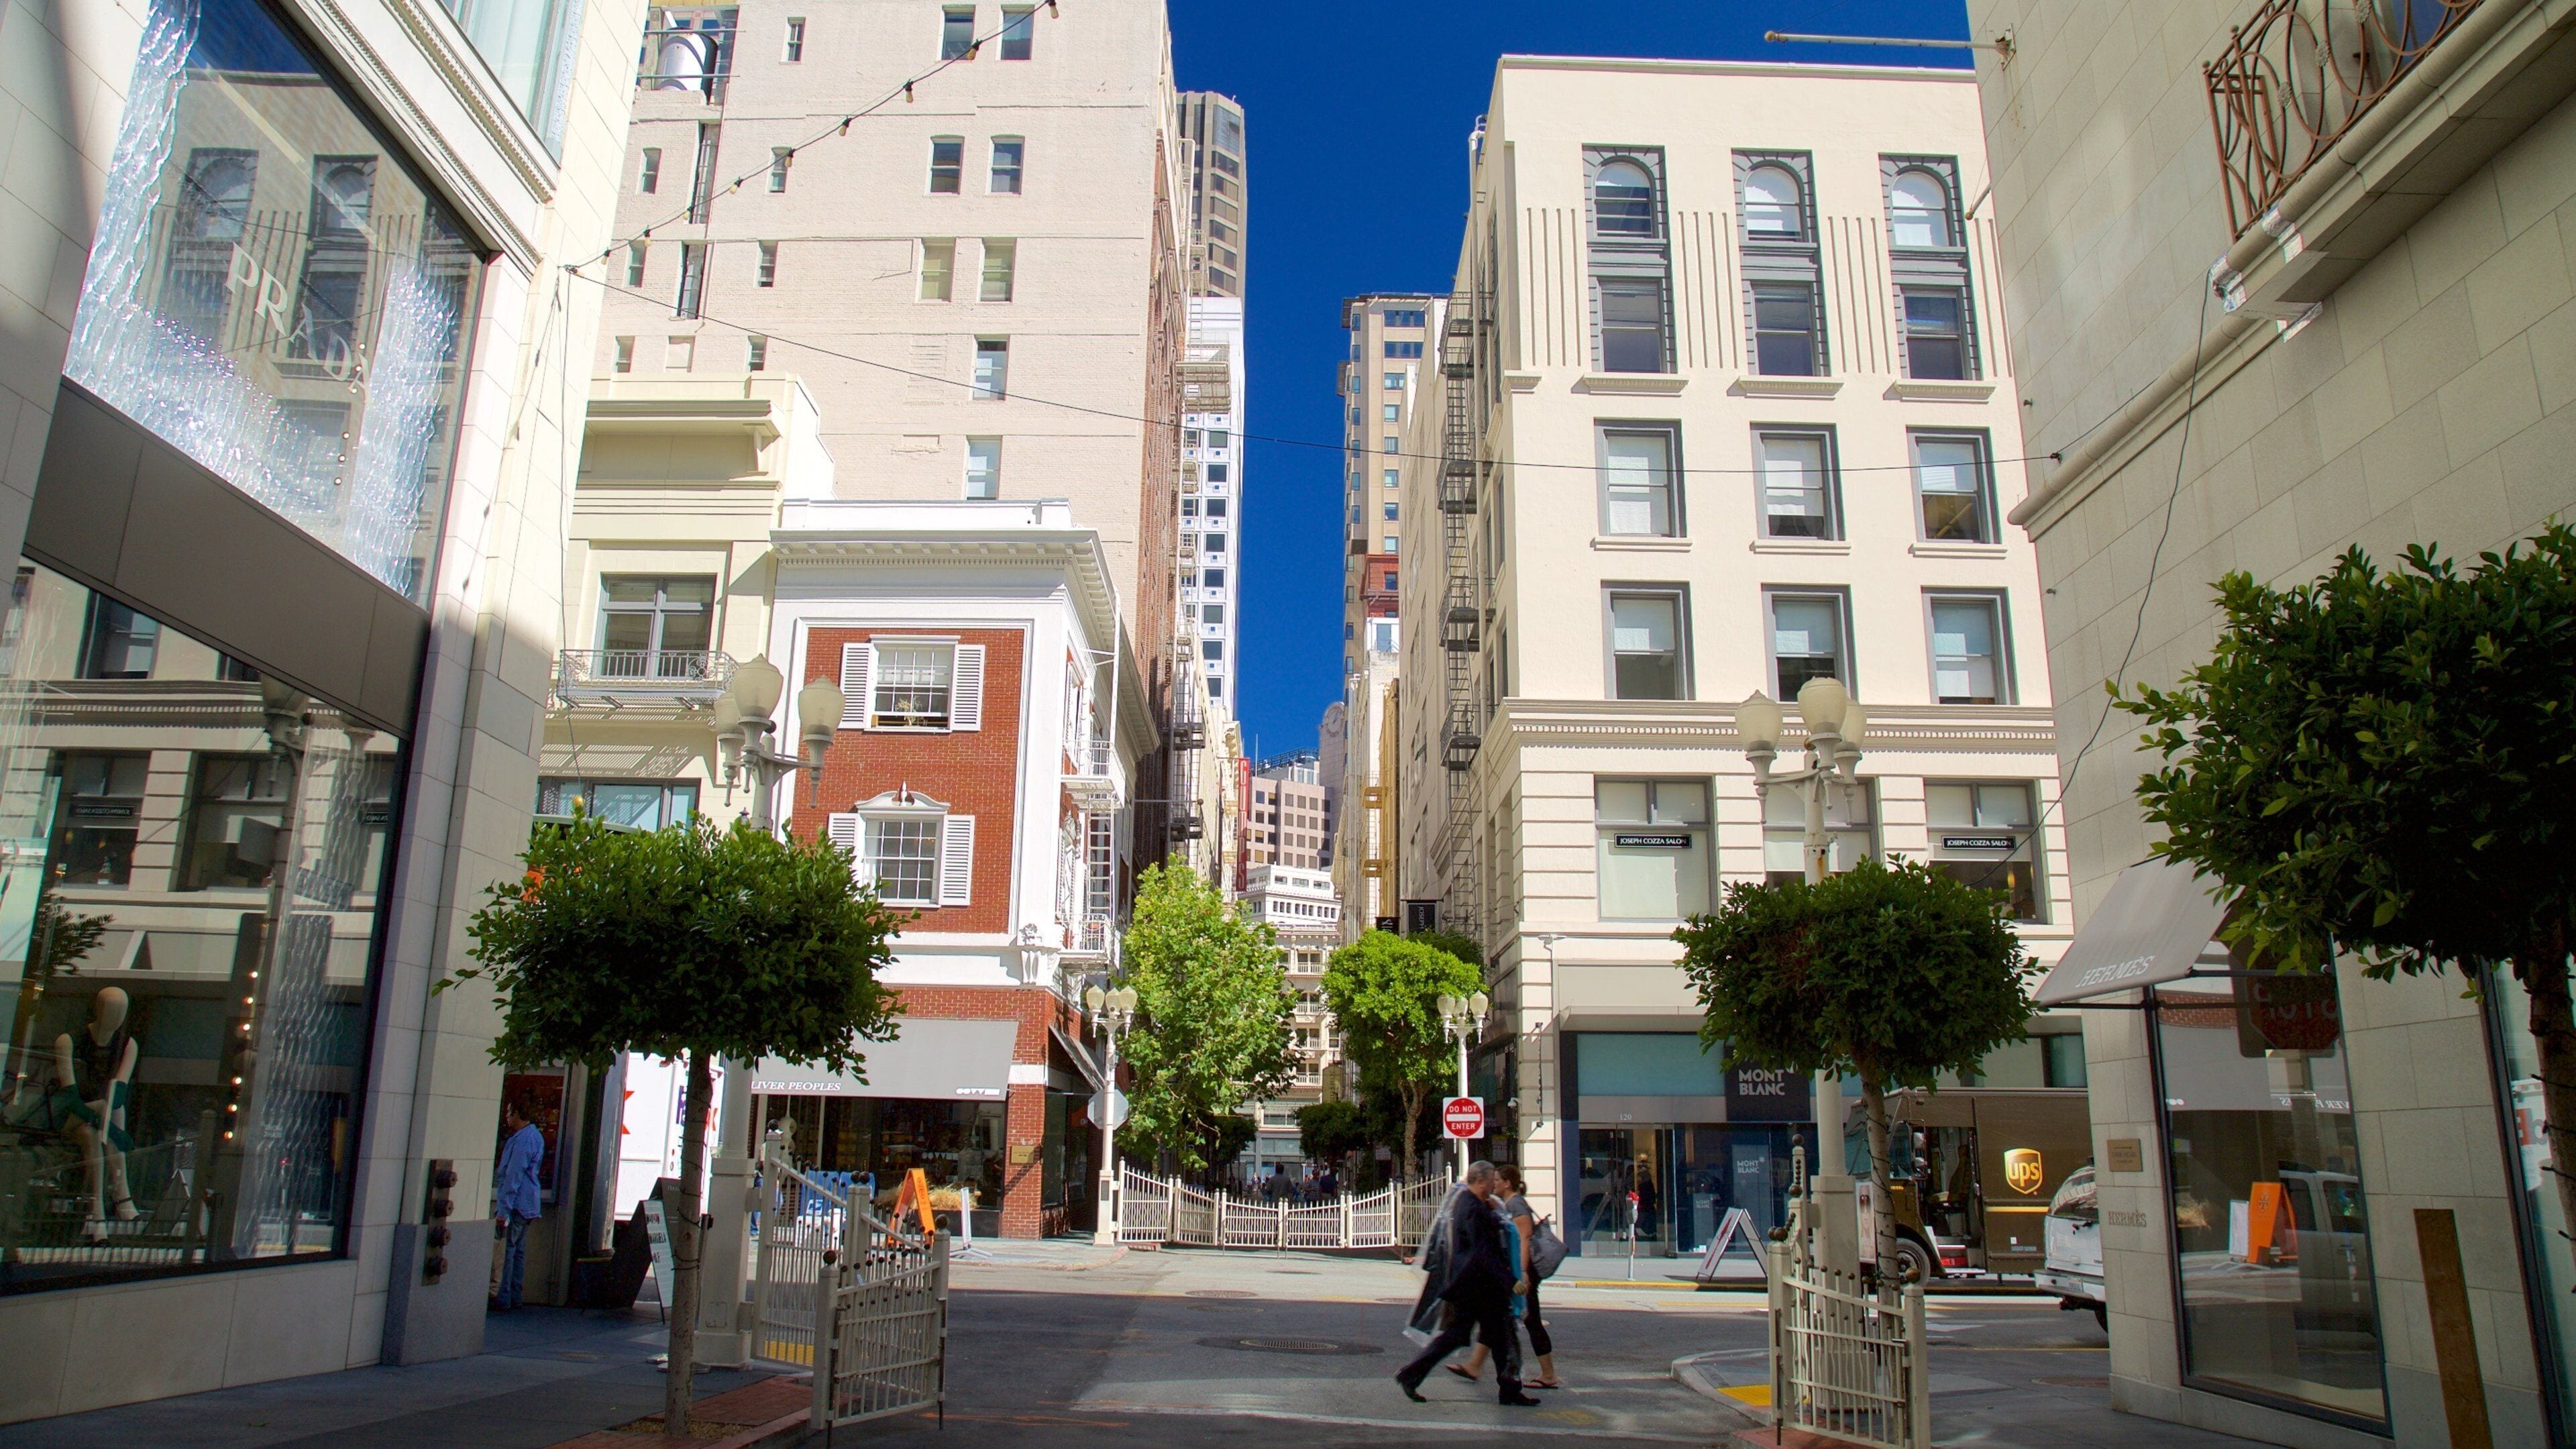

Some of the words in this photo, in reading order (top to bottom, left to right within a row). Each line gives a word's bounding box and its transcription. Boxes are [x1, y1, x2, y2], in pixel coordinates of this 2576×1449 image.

[224, 241, 370, 402] PRADA
[2075, 955, 2156, 988] HERMÈS
[1738, 1069, 1784, 1081] MONT
[751, 1081, 785, 1090] LIVER
[788, 1081, 841, 1091] PEOPLES
[1739, 1083, 1784, 1095] BLANC
[2008, 1162, 2040, 1187] ups
[2108, 1210, 2147, 1228] HERMÈS
